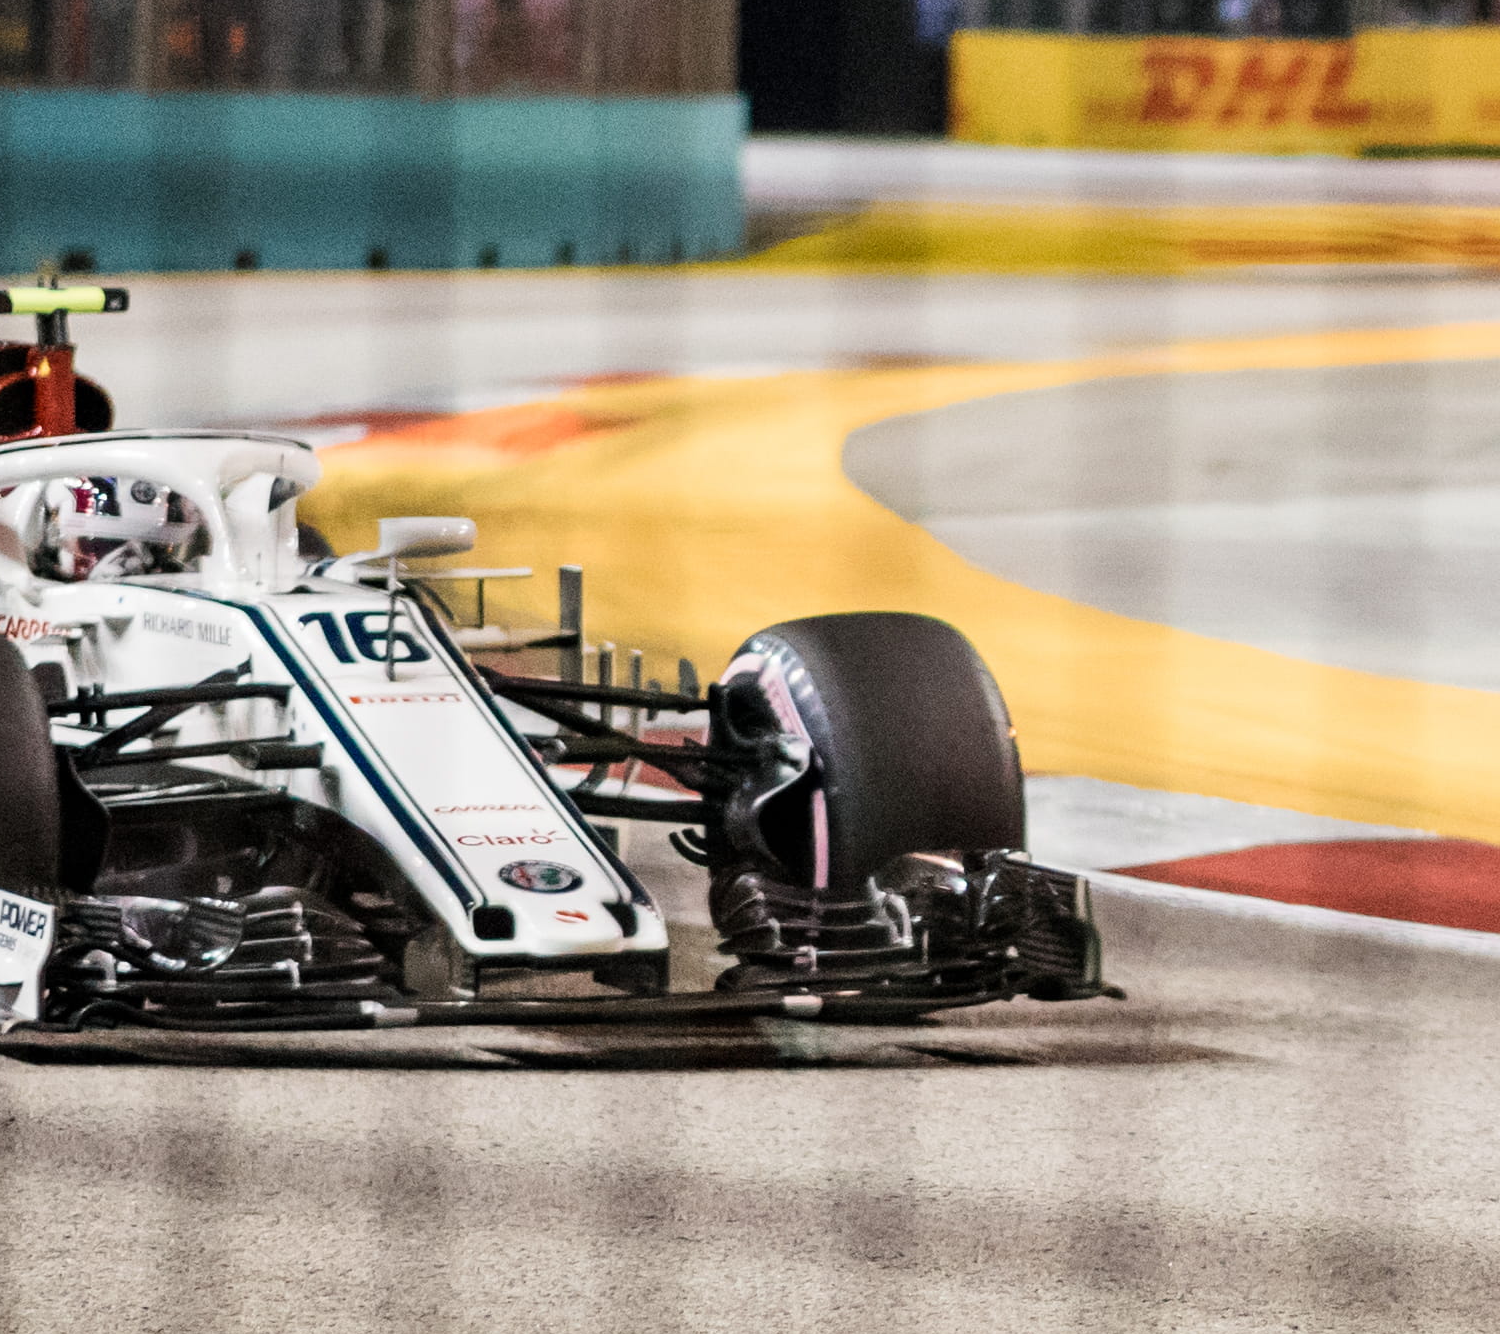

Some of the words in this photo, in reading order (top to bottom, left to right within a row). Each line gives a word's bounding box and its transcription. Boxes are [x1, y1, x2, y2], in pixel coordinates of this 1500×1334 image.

[1140, 38, 1371, 123] DHL
[143, 612, 193, 638] RICHARD
[197, 621, 231, 646] MILLE
[298, 611, 432, 663] 16
[434, 804, 546, 814] CARRERA
[457, 831, 556, 846] Claro
[0, 898, 47, 939] POWER
